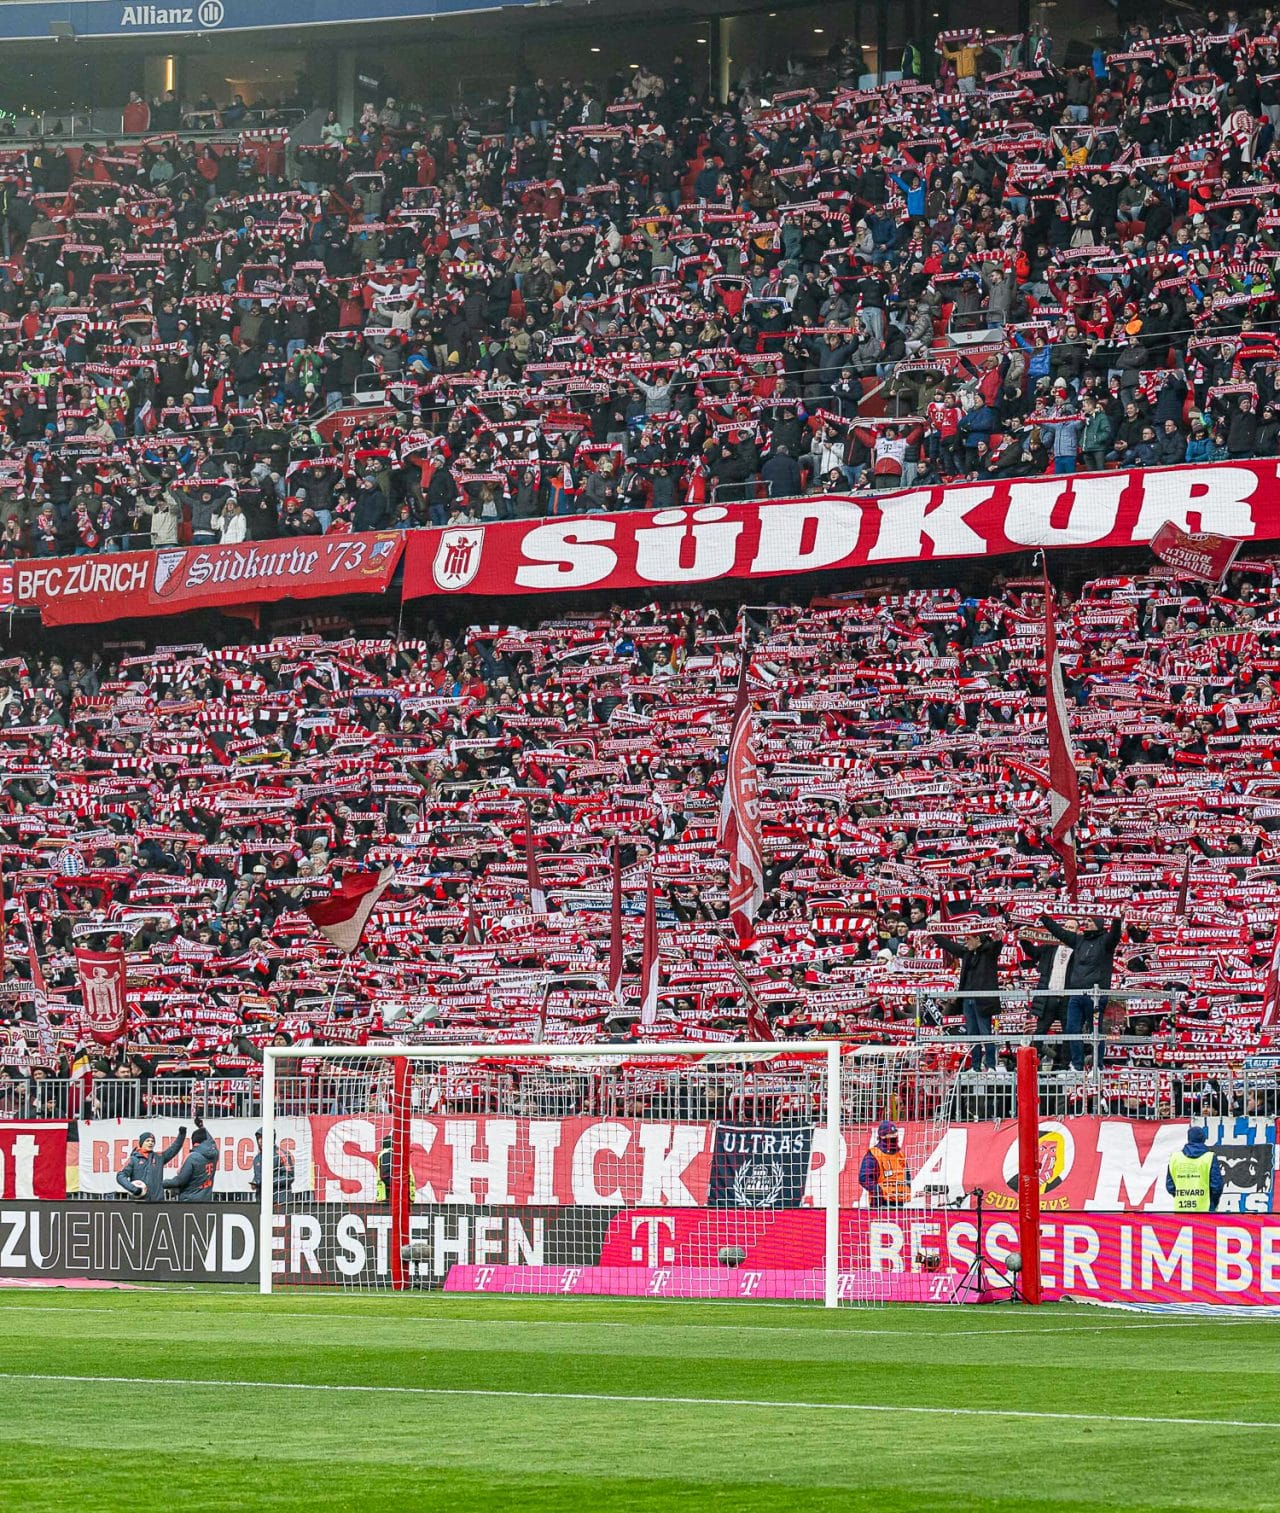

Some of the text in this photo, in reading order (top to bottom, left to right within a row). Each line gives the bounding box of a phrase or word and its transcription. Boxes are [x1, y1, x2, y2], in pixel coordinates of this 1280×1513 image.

[120, 6, 193, 26] Allianz
[342, 416, 356, 426] 223
[185, 543, 319, 588] Südkurve
[18, 568, 63, 600] BFC
[67, 560, 148, 593] ZÜRICH
[1036, 902, 1120, 917] SCHICKERIA
[723, 1130, 804, 1154] ULTRAS
[1176, 1188, 1205, 1196] TEWARD
[2, 1213, 543, 1276] ZUEINANDER STEHEN
[870, 1222, 1099, 1290] BESSER
[1120, 1225, 1192, 1291] IM
